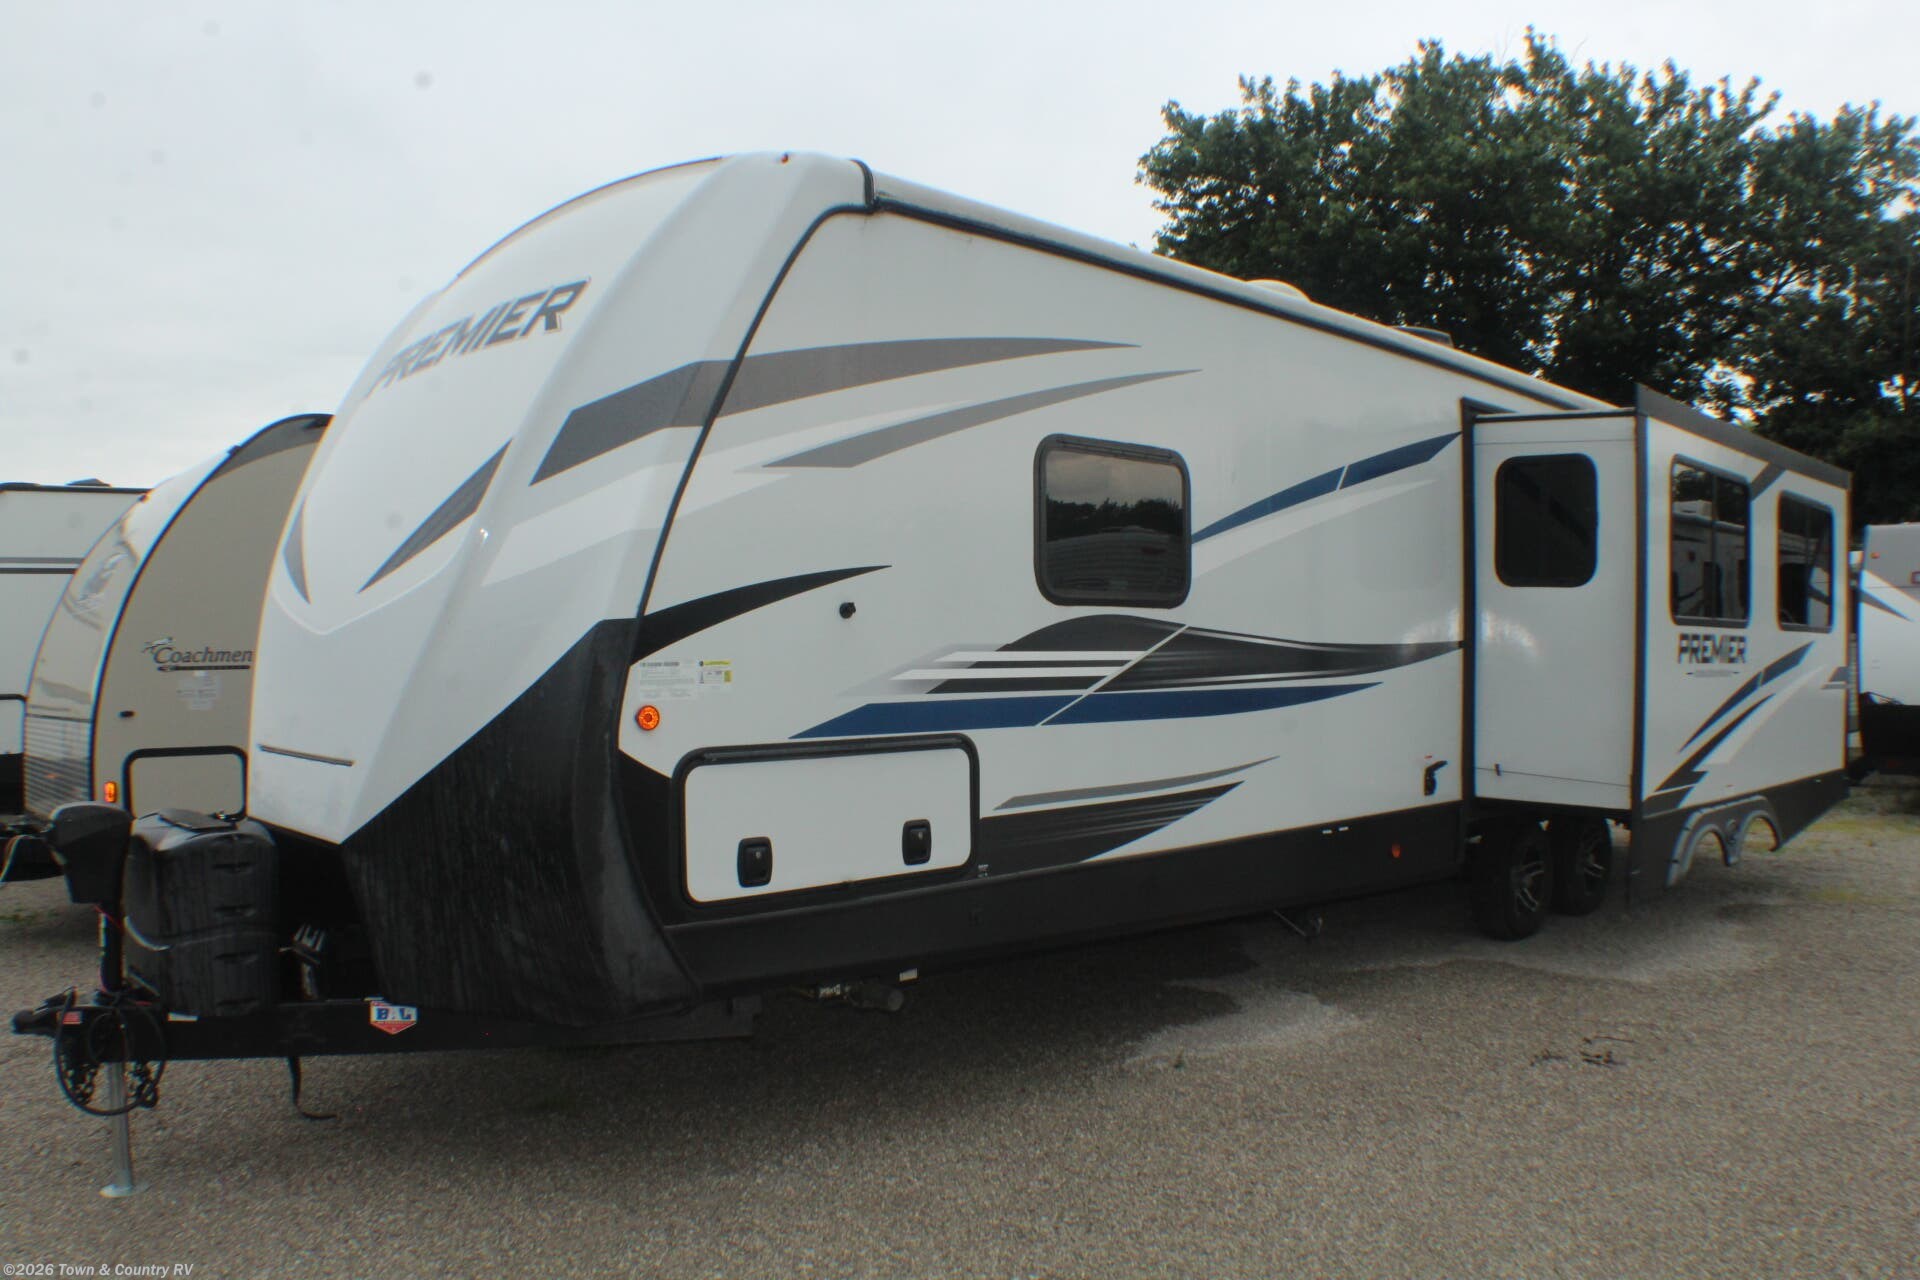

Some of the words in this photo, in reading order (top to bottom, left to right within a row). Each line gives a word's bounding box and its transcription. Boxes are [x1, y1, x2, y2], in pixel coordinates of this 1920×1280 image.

[364, 276, 590, 399] PREMIER
[154, 646, 253, 664] Coachmen
[1678, 633, 1747, 664] PREMIER
